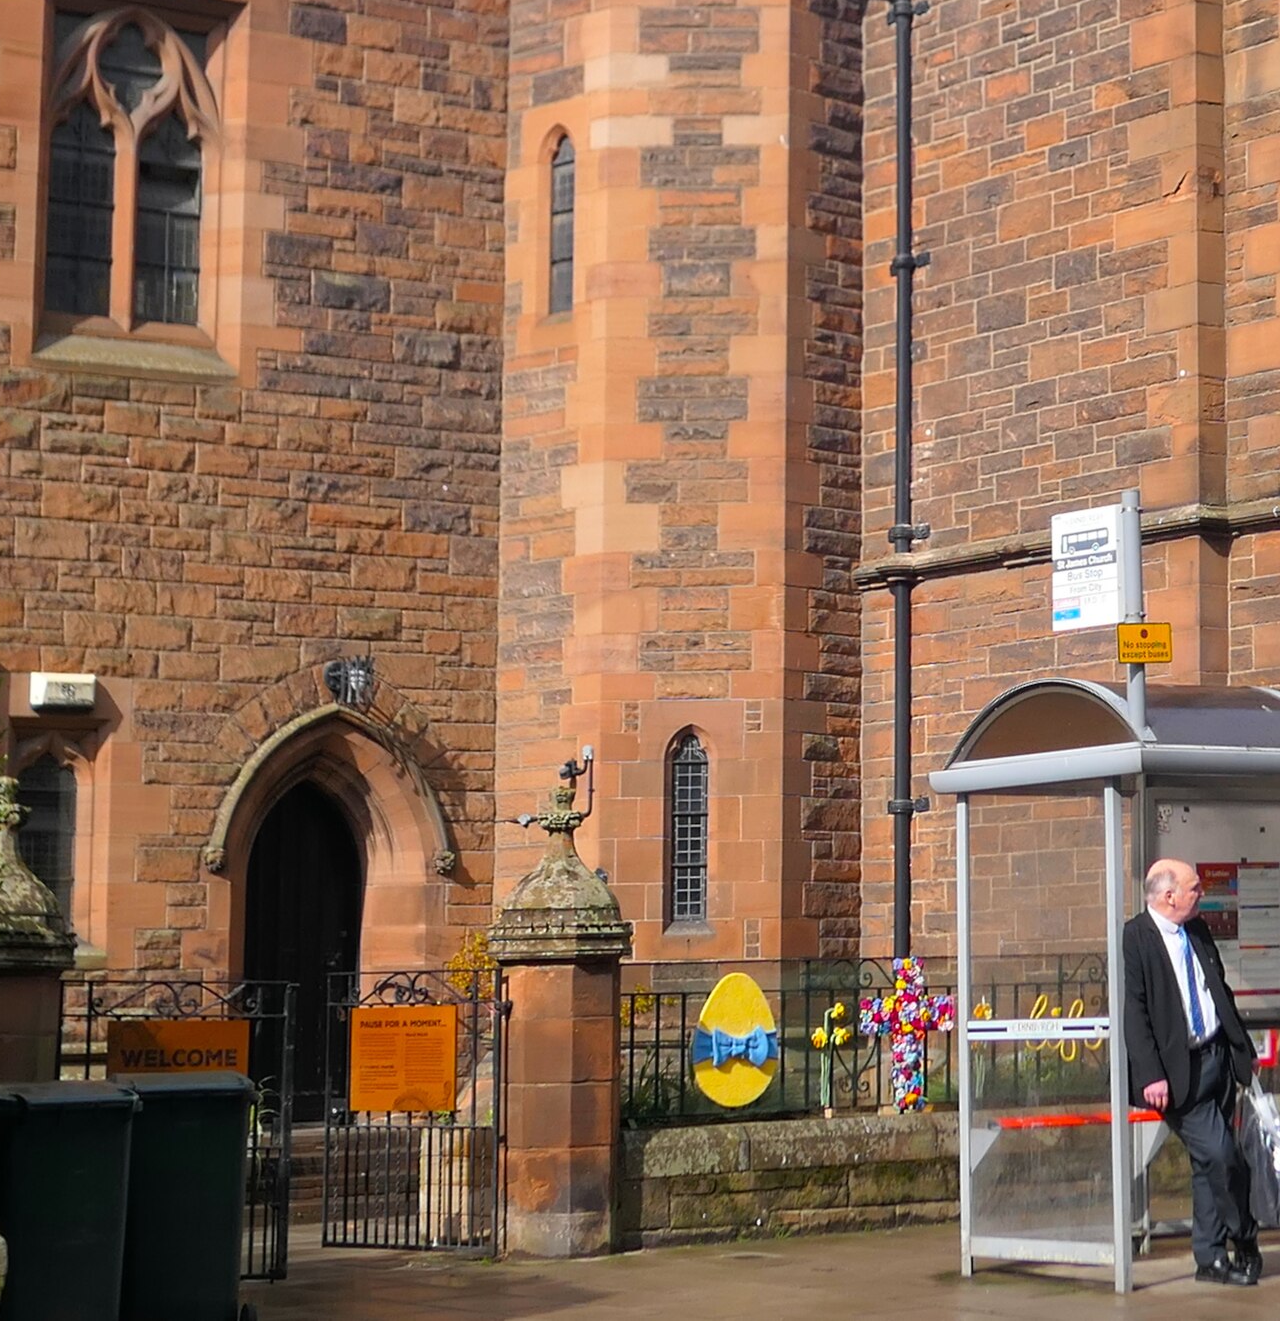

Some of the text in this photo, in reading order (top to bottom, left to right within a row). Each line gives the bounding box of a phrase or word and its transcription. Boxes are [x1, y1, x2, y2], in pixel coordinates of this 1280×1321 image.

[1088, 553, 1113, 565] Church
[1067, 568, 1103, 581] Bus Stop
[1123, 640, 1167, 650] No stopping
[1122, 650, 1169, 659] except buses
[359, 1020, 383, 1028] PAUSE
[385, 1020, 400, 1028] FOR
[402, 1020, 408, 1028] A
[121, 1048, 237, 1067] WELCOME
